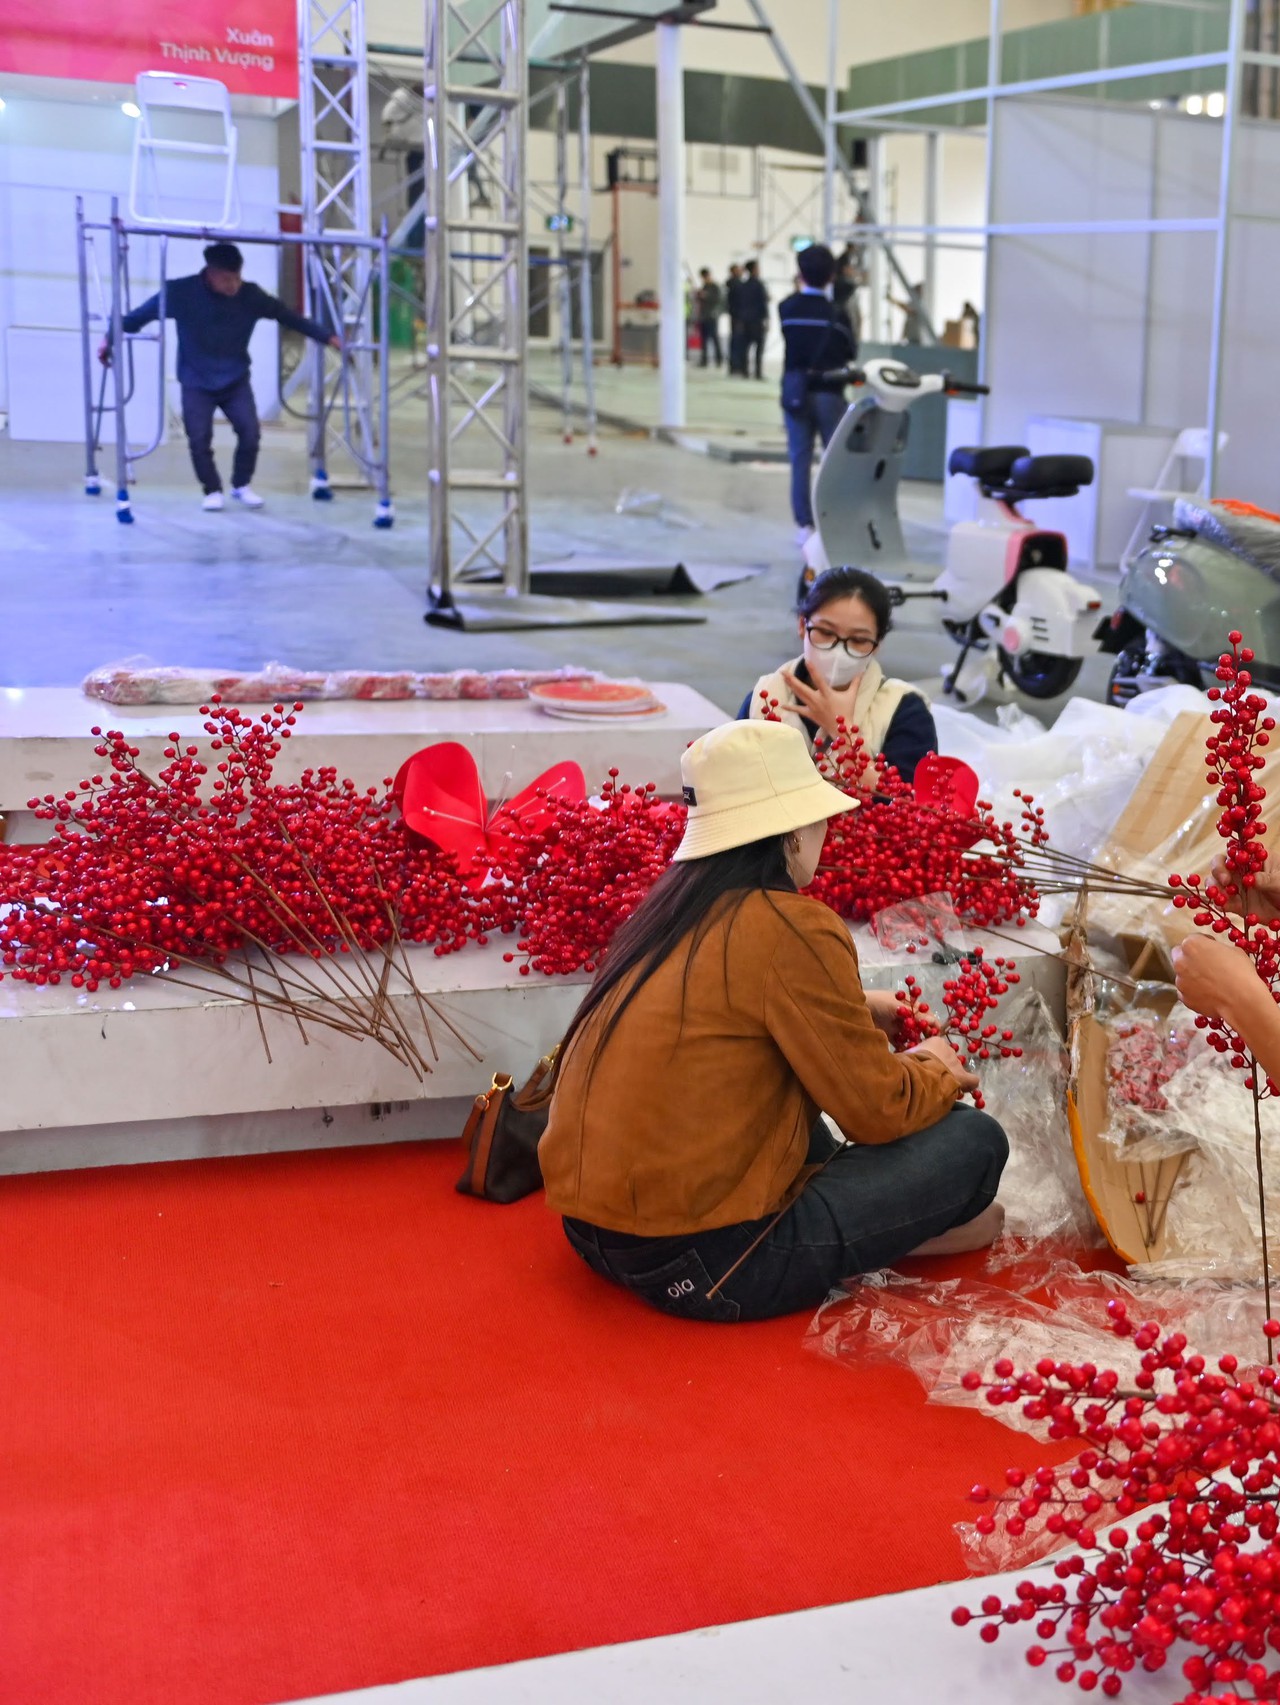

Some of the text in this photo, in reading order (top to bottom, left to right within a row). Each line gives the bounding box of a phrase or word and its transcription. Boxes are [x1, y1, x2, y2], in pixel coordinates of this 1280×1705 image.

[226, 26, 275, 47] Xuân
[160, 42, 275, 72] Thịnh Vượng
